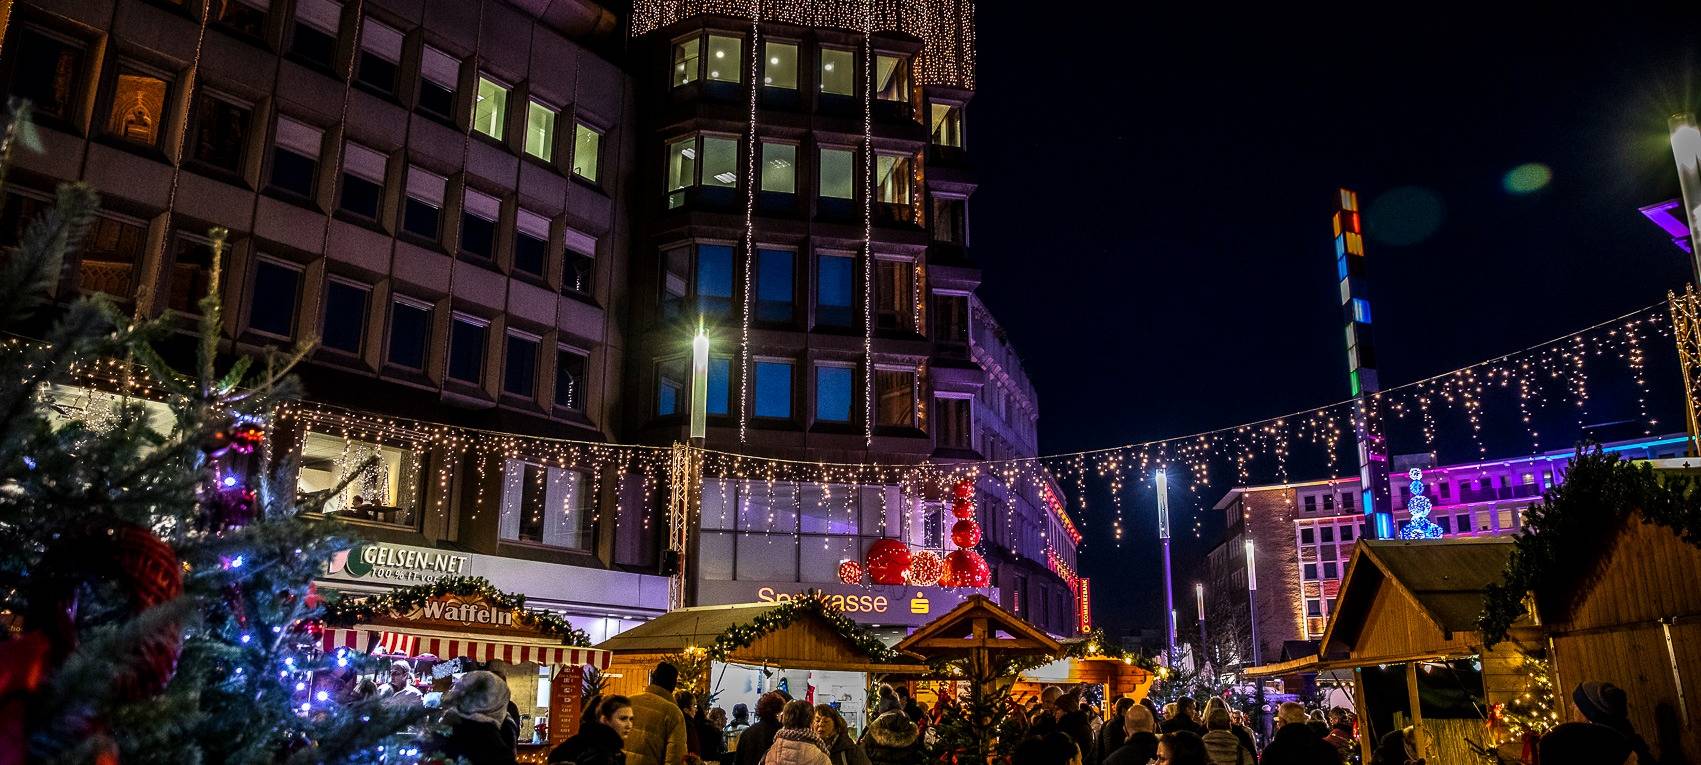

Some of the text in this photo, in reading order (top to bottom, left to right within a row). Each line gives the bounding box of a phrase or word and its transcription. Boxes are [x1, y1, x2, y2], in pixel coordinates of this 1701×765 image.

[364, 546, 468, 574] GELSEN-NET
[372, 567, 392, 578] 100
[394, 569, 404, 580] %
[423, 600, 512, 625] Waffeln
[757, 587, 888, 613] Skasse
